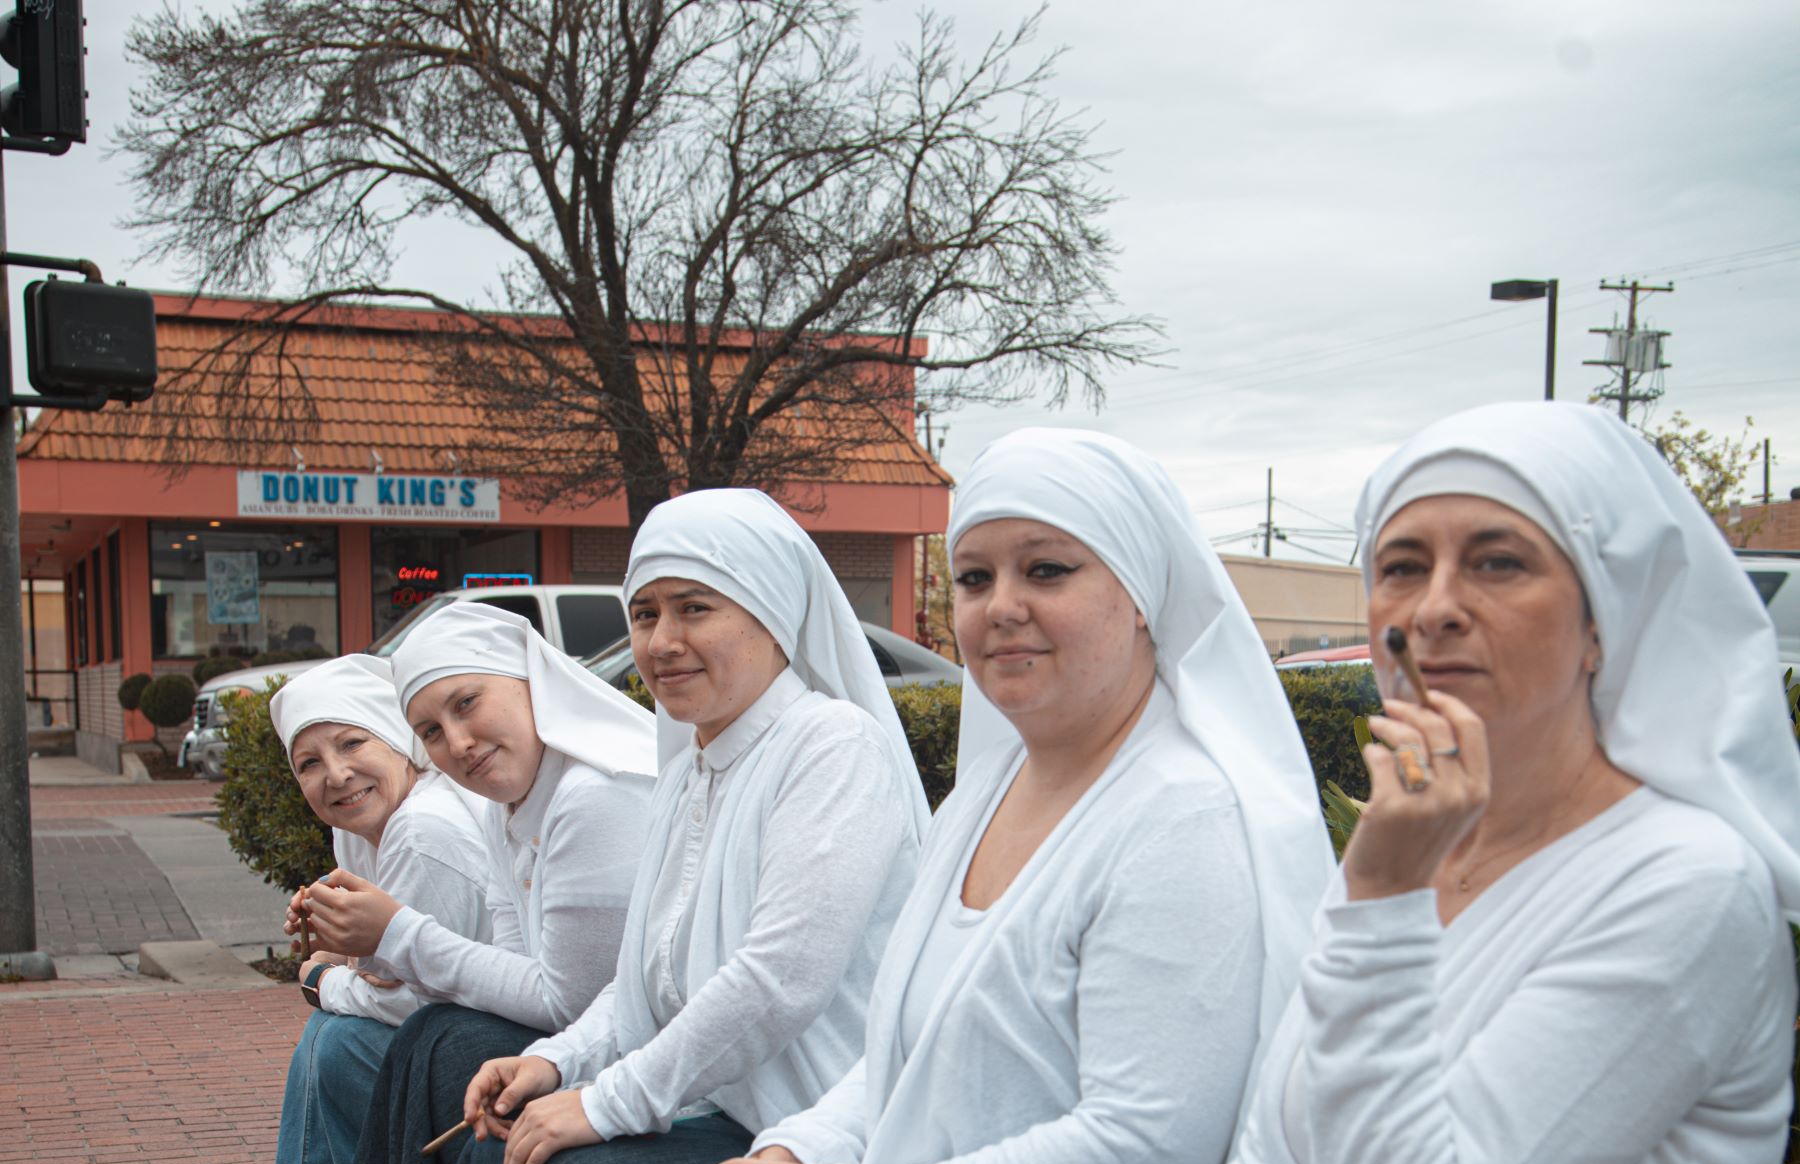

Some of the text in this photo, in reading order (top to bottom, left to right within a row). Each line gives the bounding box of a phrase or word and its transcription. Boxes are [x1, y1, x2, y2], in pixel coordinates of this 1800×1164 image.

[263, 474, 477, 507] DONUT KING'S
[242, 503, 496, 519] ASIAN SUBS BOBA DRINKS FRESH ROASTED COFFEE
[398, 566, 438, 579] Coffee
